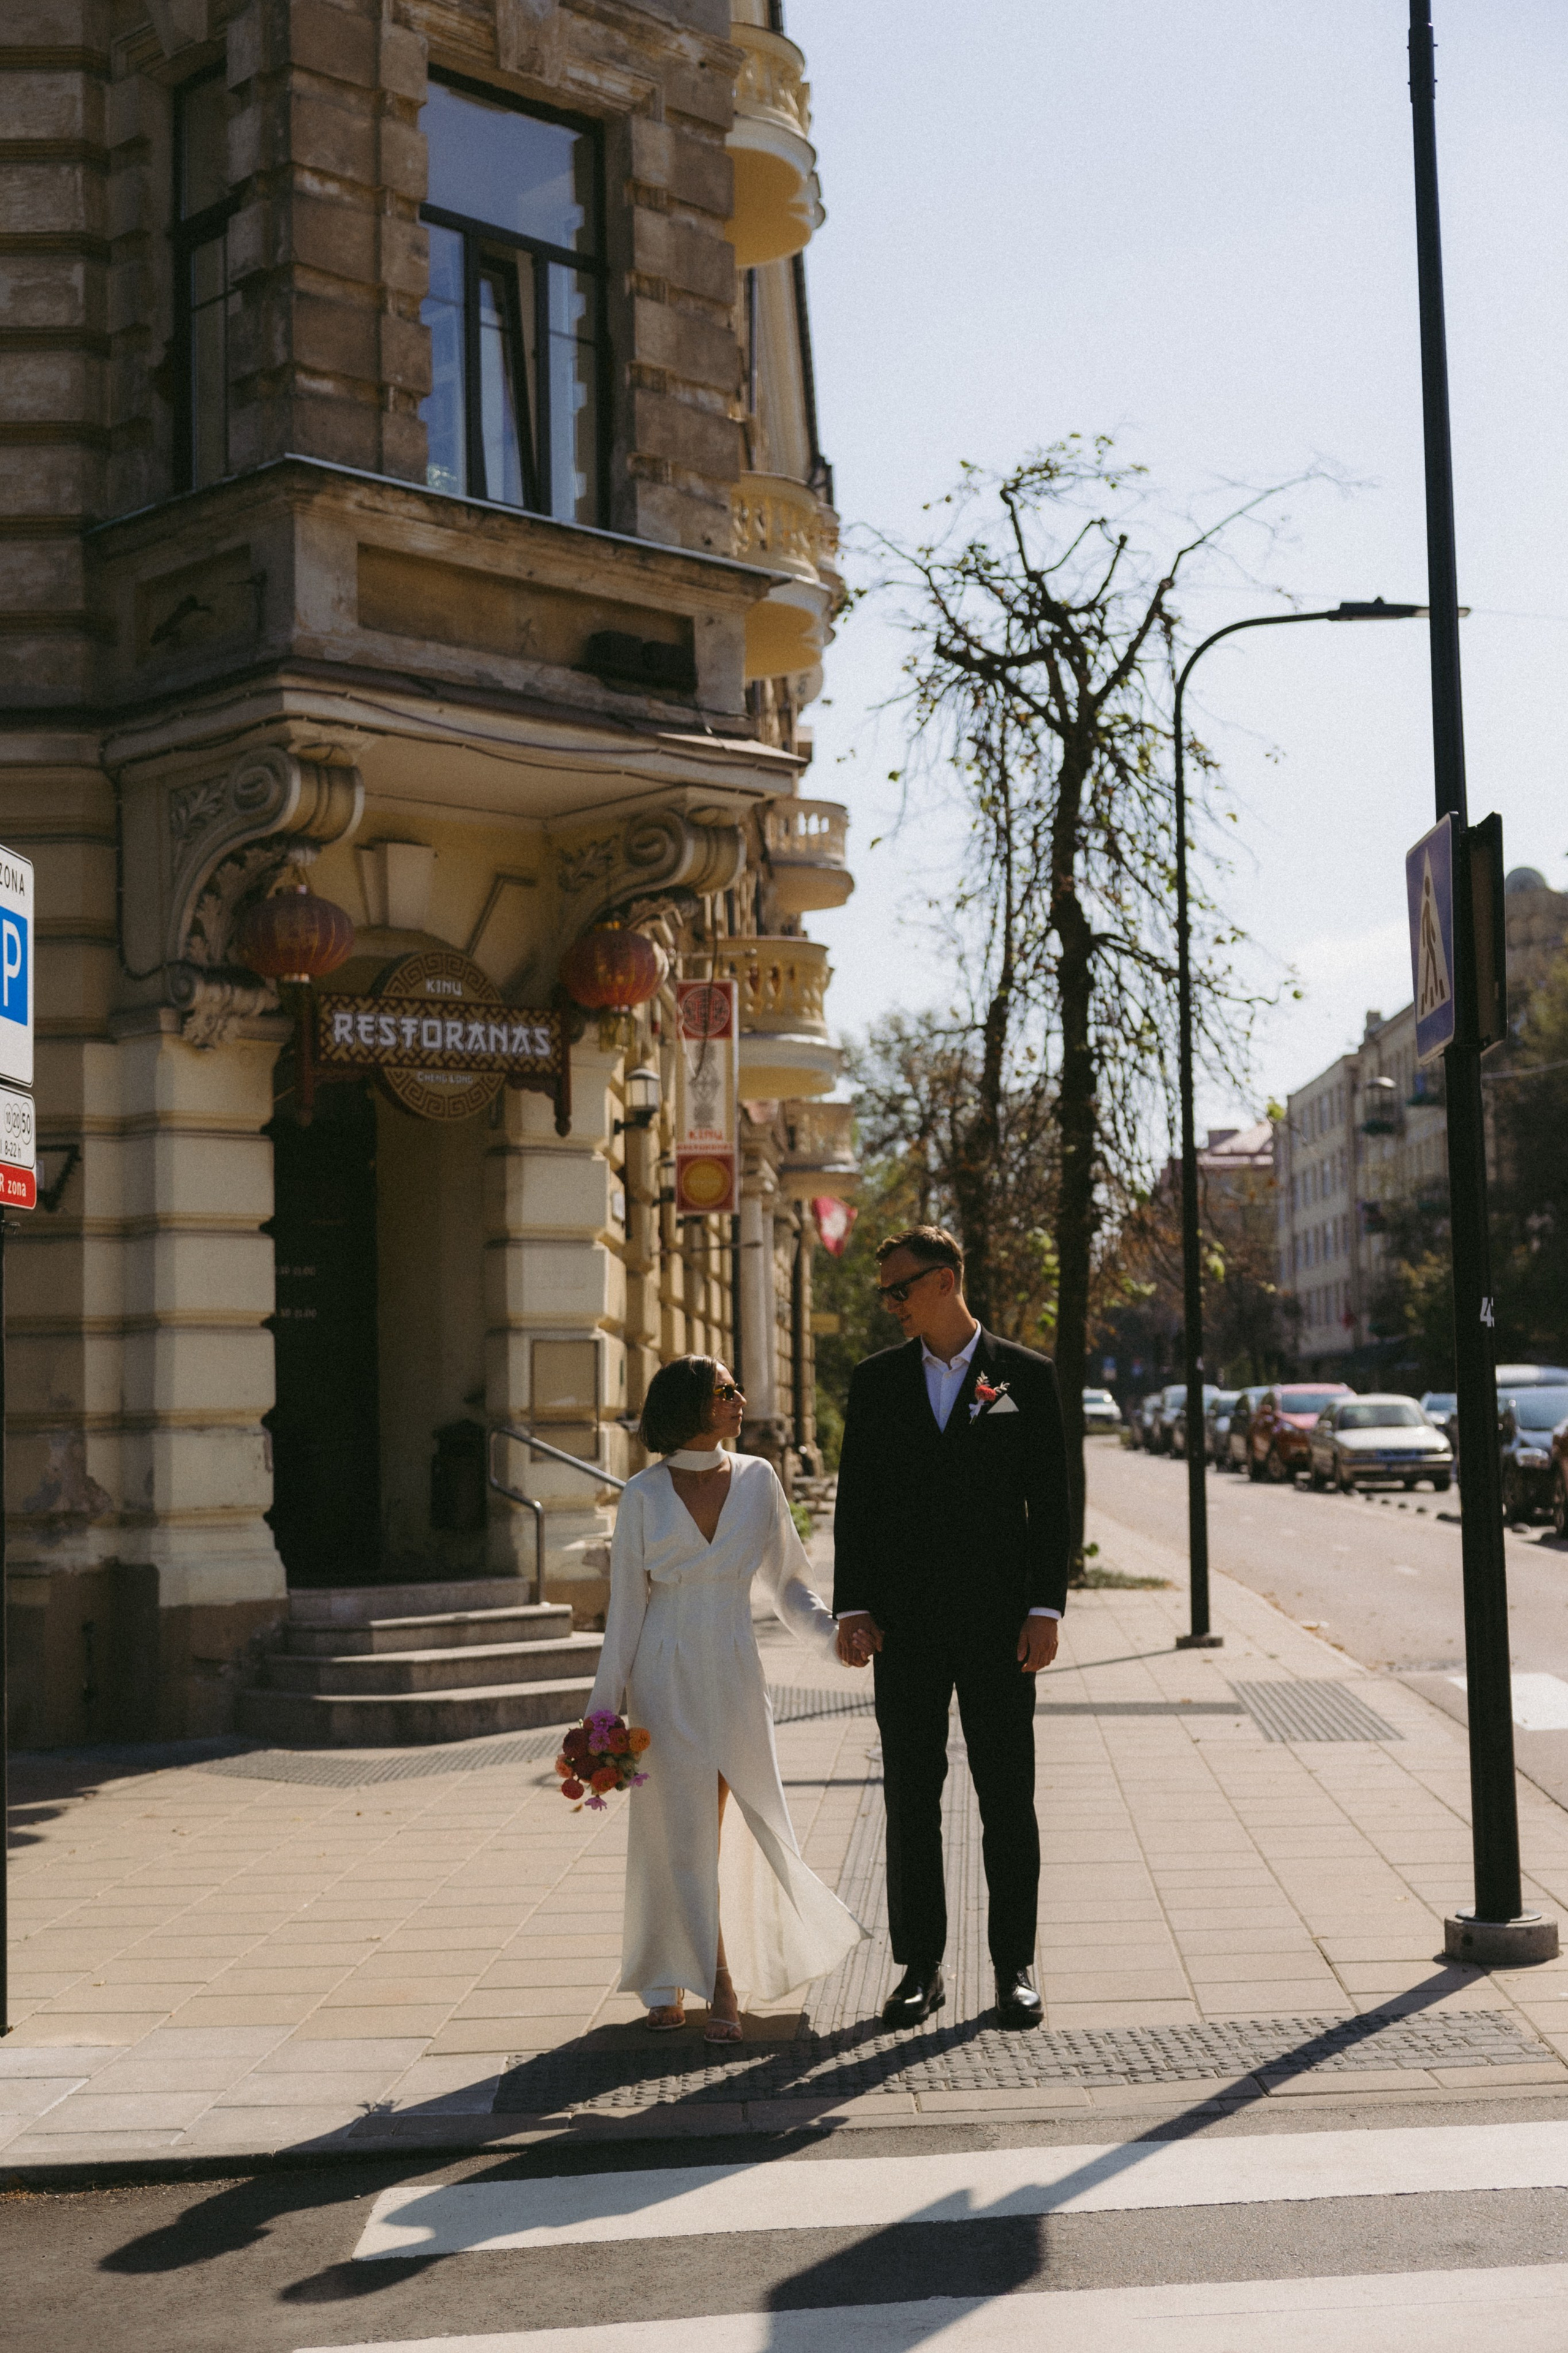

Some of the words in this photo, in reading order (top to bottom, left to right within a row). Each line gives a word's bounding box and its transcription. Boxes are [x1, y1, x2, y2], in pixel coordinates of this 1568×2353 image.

[2, 918, 22, 1007] P
[426, 978, 463, 996] KINU
[333, 1012, 551, 1057] RESTORANAS
[12, 1112, 20, 1129] 20
[22, 1112, 31, 1134] 50
[8, 1179, 26, 1196] zona
